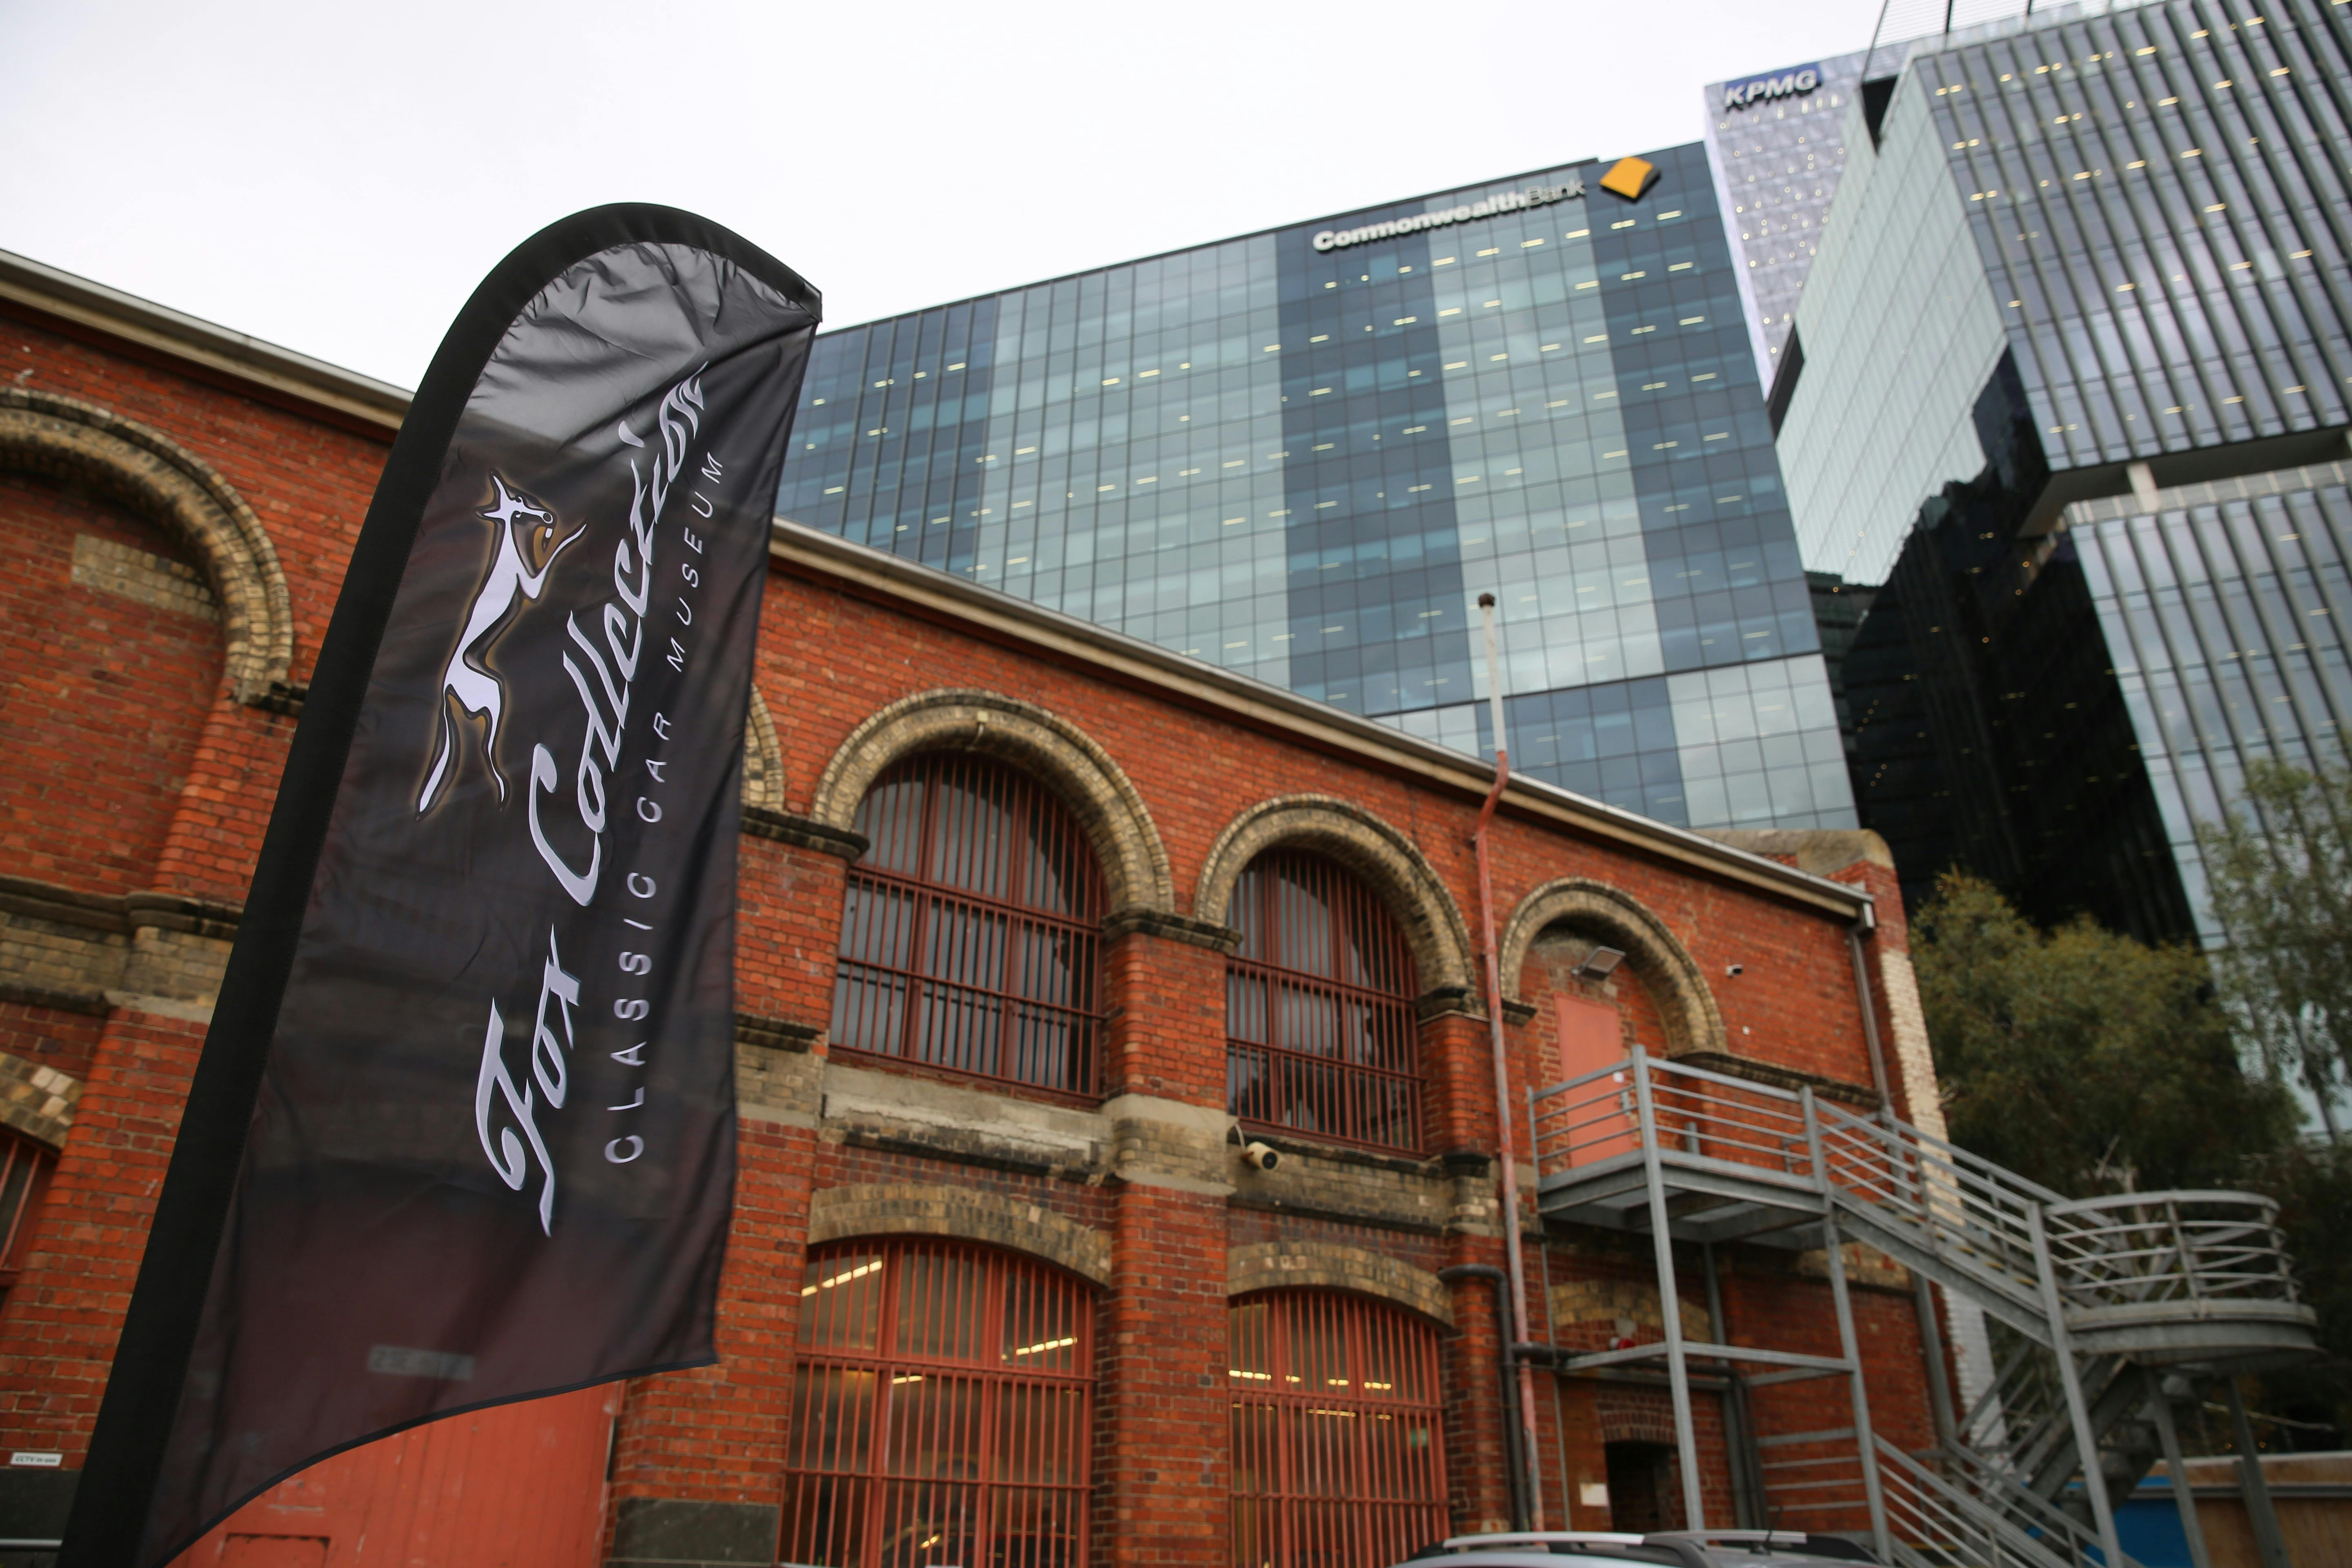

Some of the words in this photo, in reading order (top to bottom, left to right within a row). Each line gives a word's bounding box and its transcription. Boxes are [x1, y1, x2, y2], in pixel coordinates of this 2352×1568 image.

[1312, 178, 1586, 251] CommonwealthBank
[1724, 69, 1817, 107] KPMG
[476, 923, 580, 1237] Fox
[529, 361, 708, 906] Collection
[604, 872, 656, 1163] CLASSIC
[637, 712, 671, 822] CAR
[667, 452, 723, 672] MUSEUM
